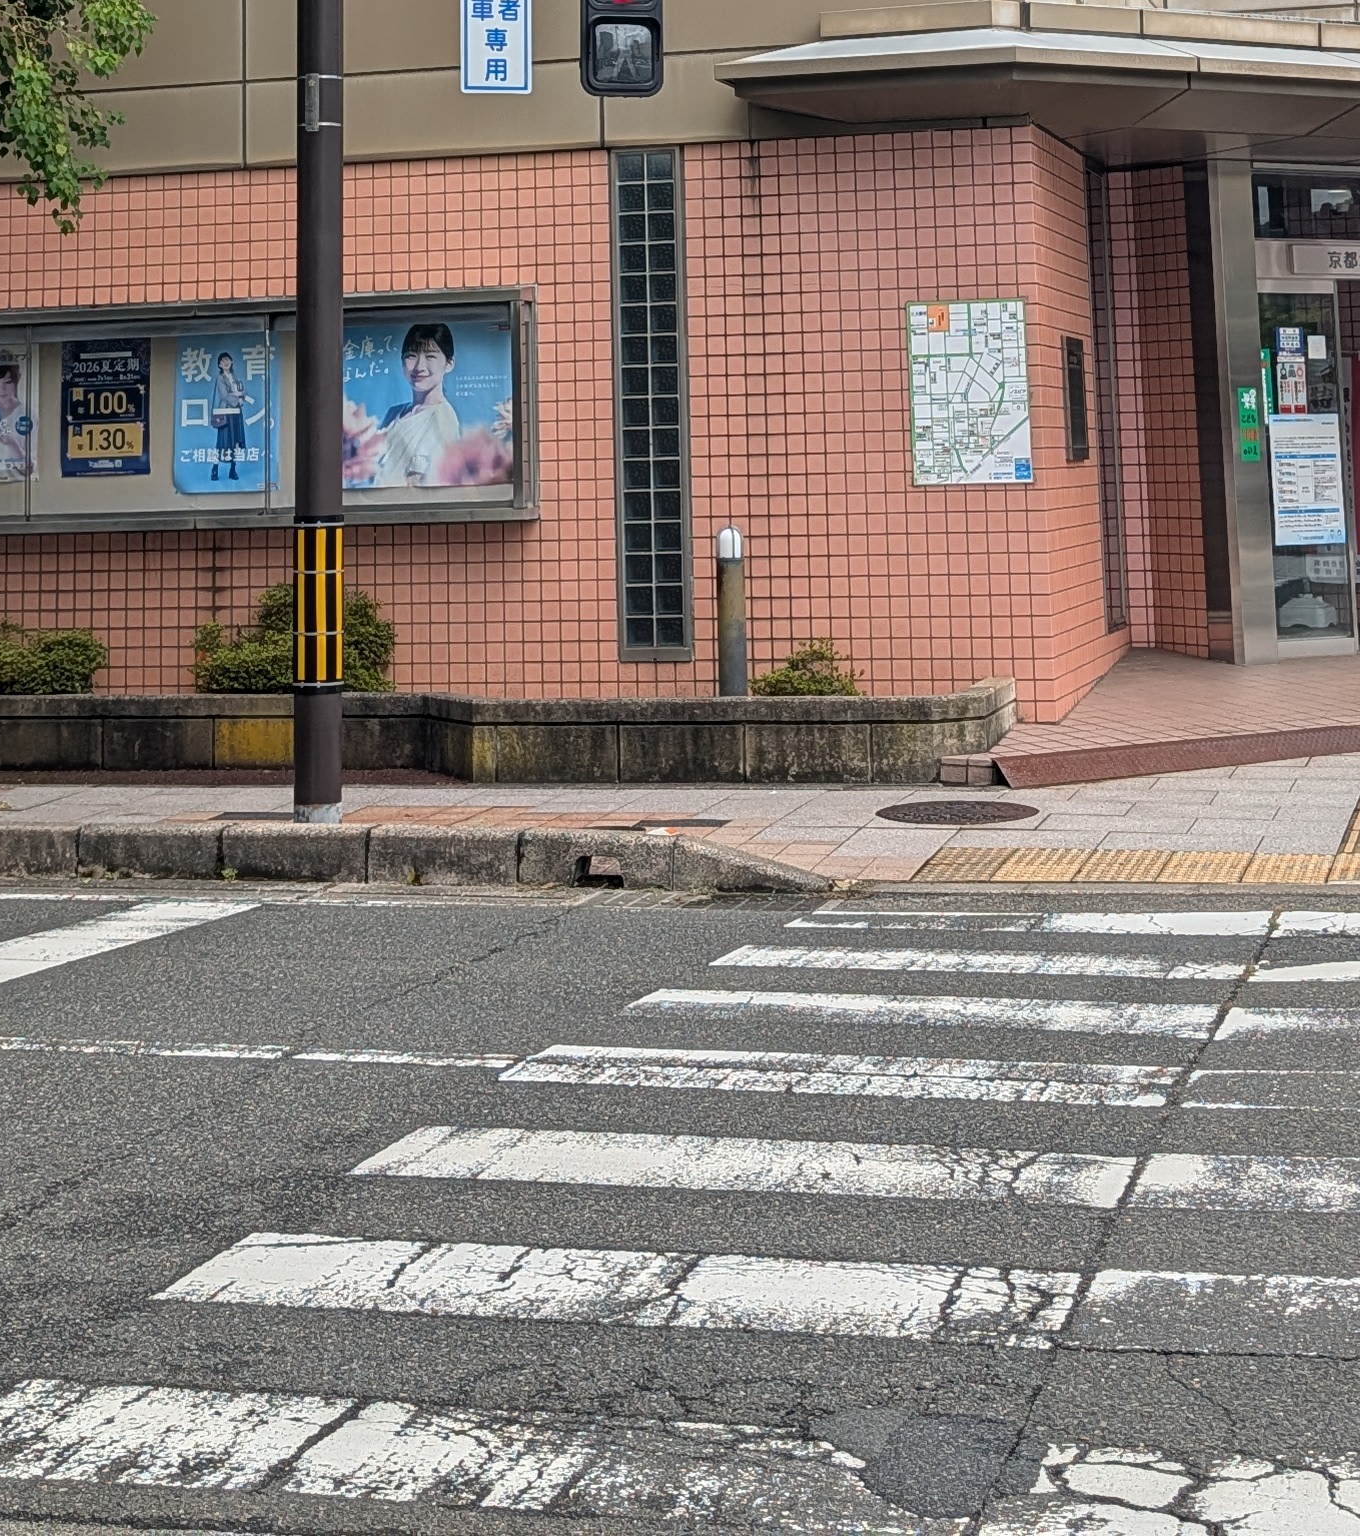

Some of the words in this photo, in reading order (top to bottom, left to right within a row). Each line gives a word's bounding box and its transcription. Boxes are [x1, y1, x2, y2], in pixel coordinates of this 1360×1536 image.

[485, 27, 508, 82] 専用
[73, 358, 140, 373] 2026夏定期
[181, 344, 275, 383] 教育
[87, 390, 136, 415] 1.00%
[86, 428, 134, 451] 1.30%
